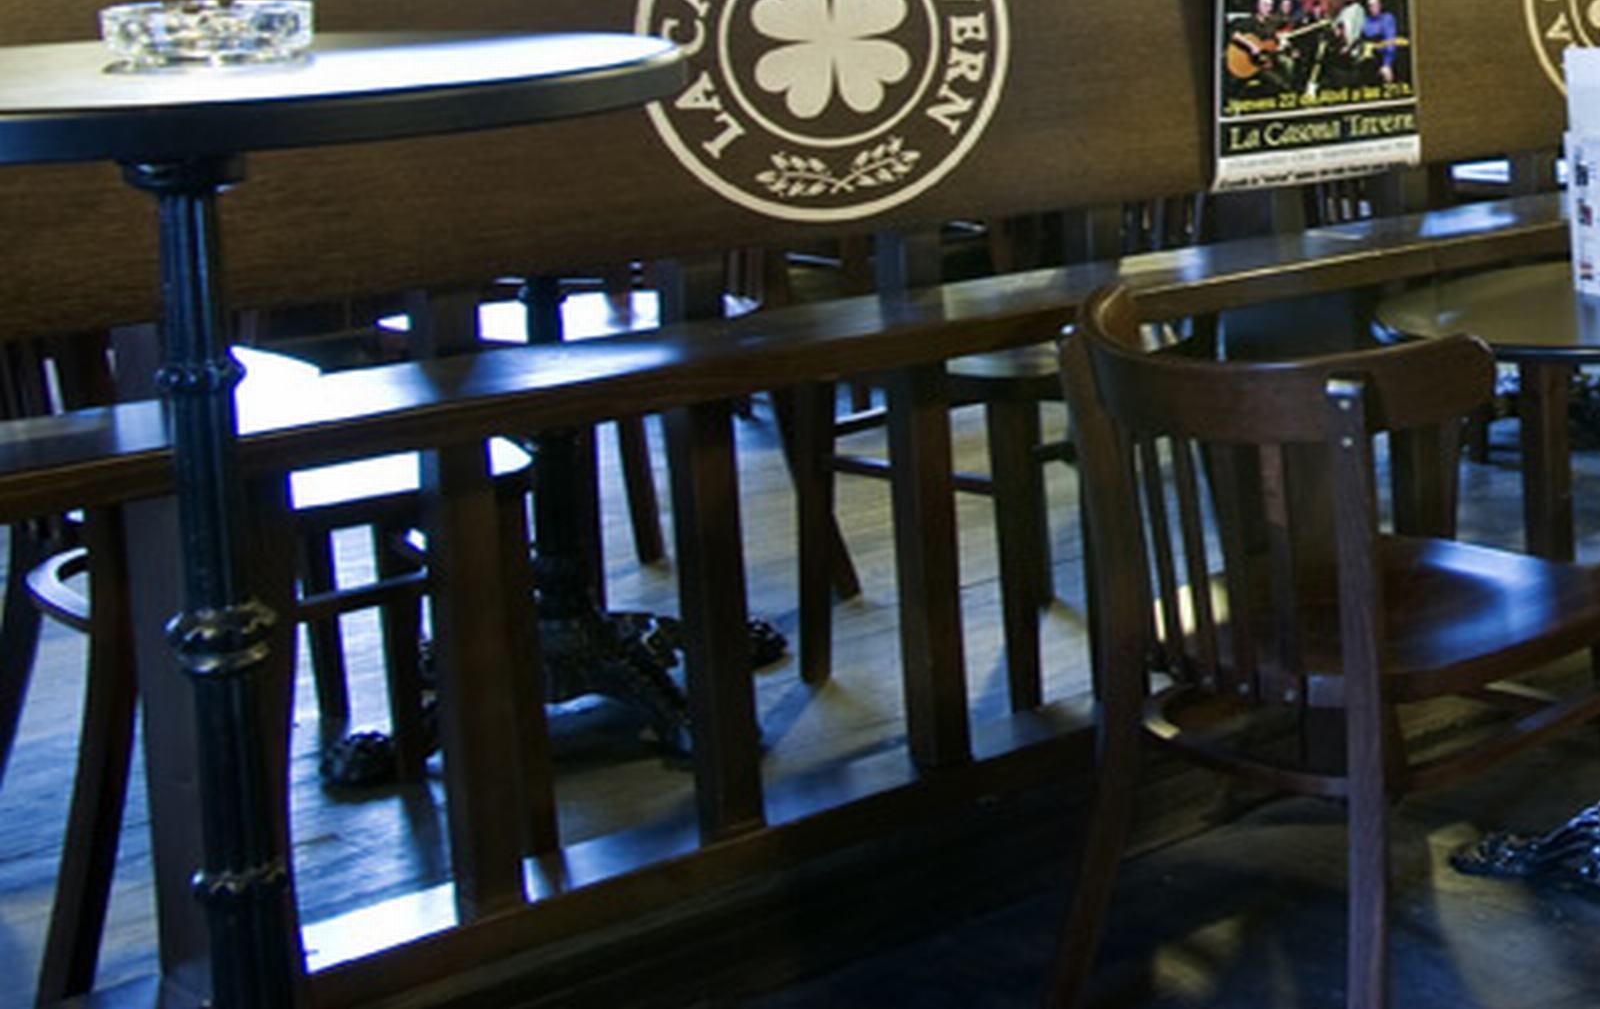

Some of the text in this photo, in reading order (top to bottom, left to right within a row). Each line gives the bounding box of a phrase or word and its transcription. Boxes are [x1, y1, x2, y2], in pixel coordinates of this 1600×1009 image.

[673, 71, 746, 159] LA
[1229, 126, 1261, 150] La
[1264, 120, 1341, 146] Casona
